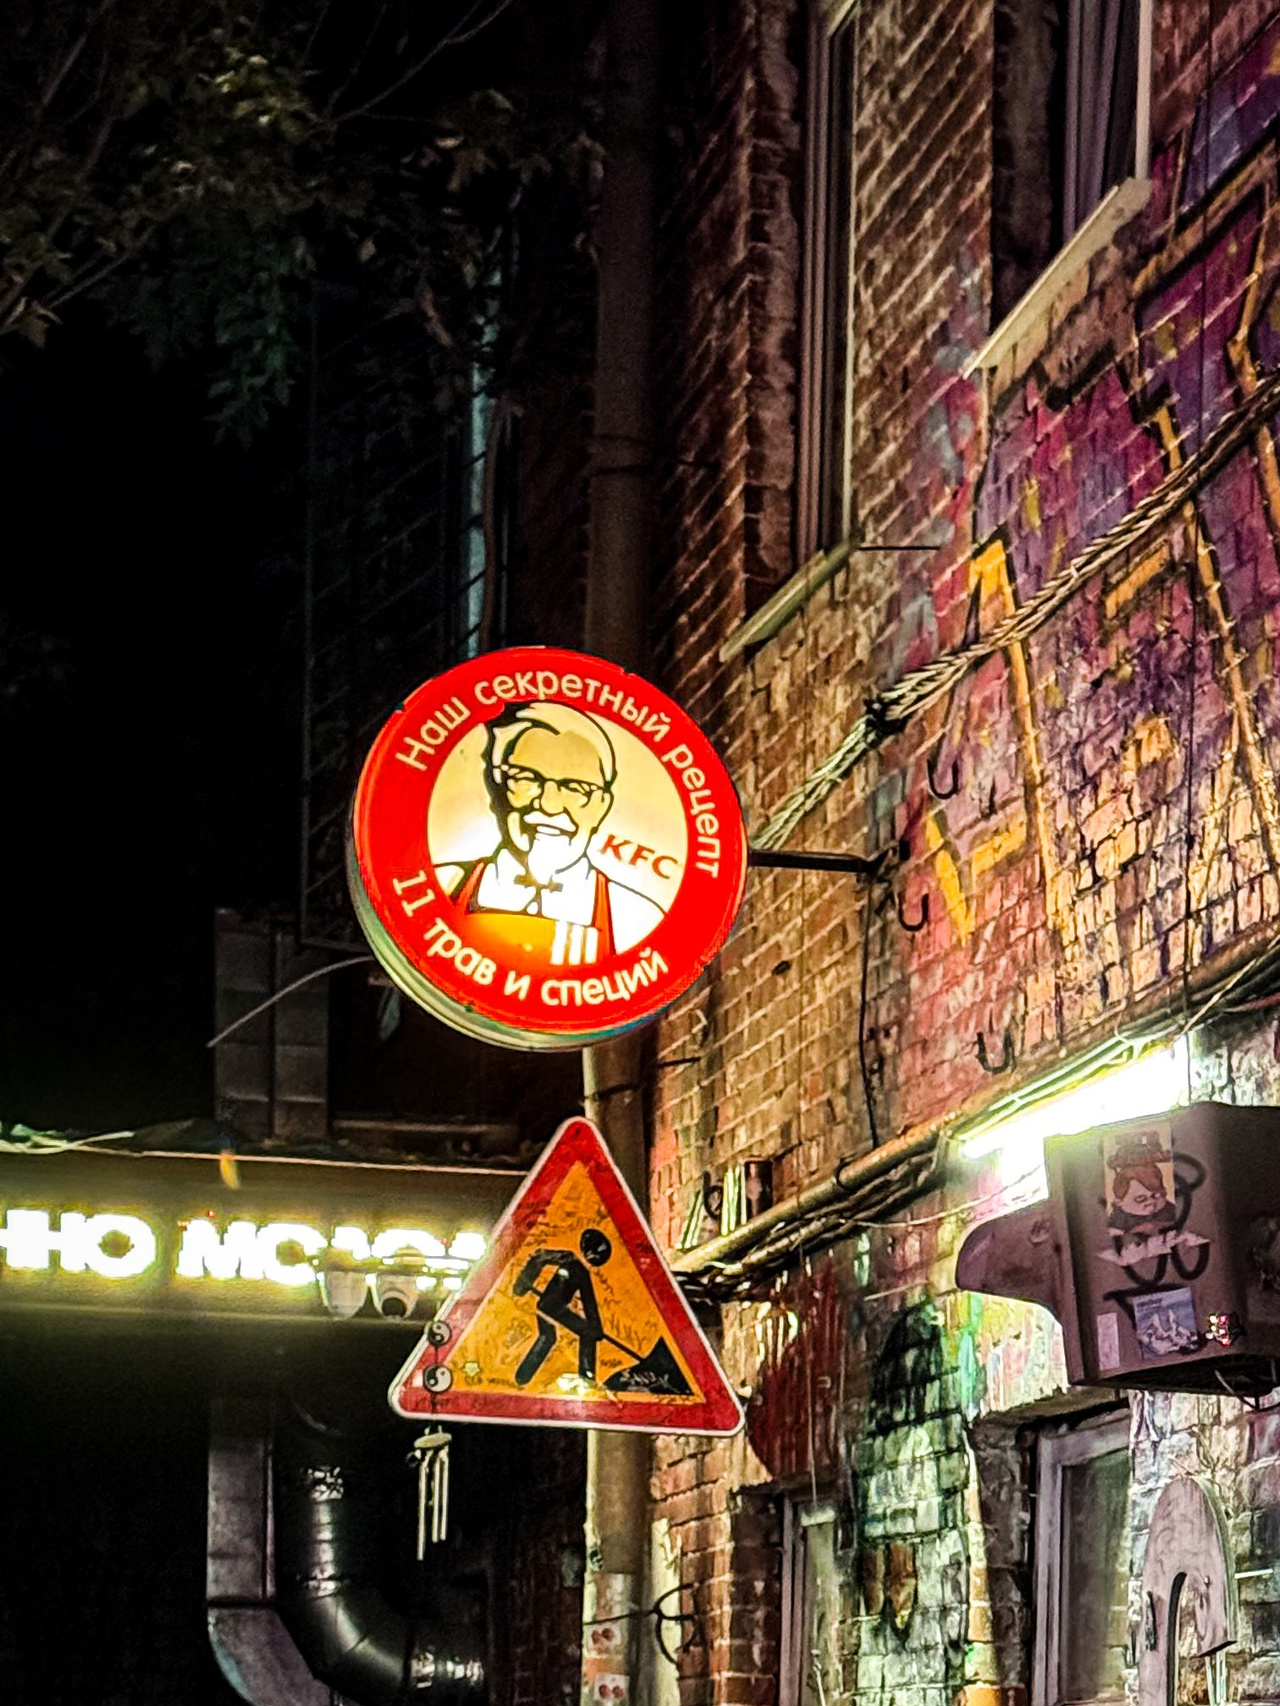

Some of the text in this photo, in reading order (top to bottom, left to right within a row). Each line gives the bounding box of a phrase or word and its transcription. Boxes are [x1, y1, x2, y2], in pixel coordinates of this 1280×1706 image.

[395, 670, 720, 877] Наш секретный рецепт
[600, 834, 681, 879] KFC
[393, 870, 671, 1006] 11 трав и специй
